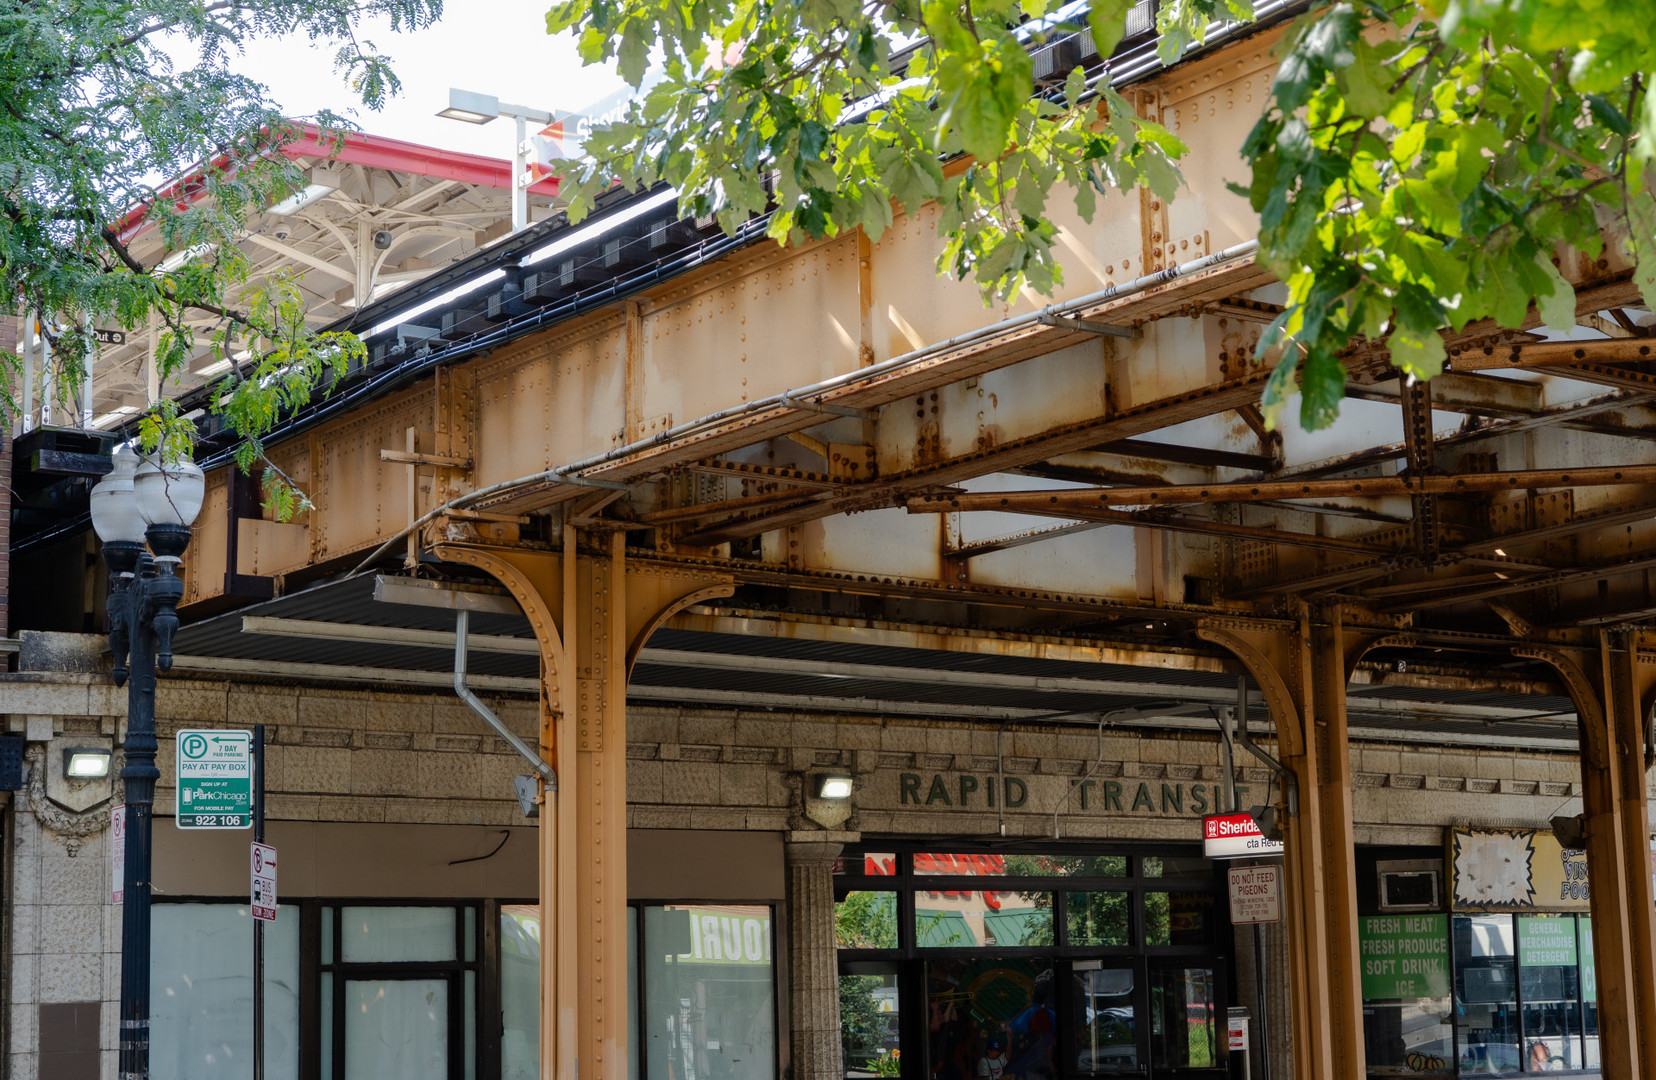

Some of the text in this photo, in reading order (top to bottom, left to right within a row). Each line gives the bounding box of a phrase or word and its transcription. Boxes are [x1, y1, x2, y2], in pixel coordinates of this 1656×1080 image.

[92, 331, 108, 341] Out
[182, 763, 246, 771] PAY AT PAY BOX
[193, 791, 247, 802] ParkChicago
[900, 773, 1249, 815] RAPID TRANSIT
[195, 815, 217, 826] 922
[220, 815, 240, 826] 106
[1219, 819, 1260, 835] Sherida
[1246, 839, 1259, 848] cta
[1231, 872, 1274, 885] DO NOT FEED
[262, 880, 271, 893] BUS
[1238, 884, 1268, 896] PIGEONS
[1560, 881, 1590, 900] FOO
[262, 893, 273, 906] STOP
[253, 905, 274, 919] TOW ZONE
[1367, 918, 1400, 934] FRESH
[1529, 922, 1562, 934] GENERAL
[1362, 938, 1446, 954] FRESH PRODUCE
[1526, 950, 1569, 962] DETERGENT
[1366, 959, 1395, 975] SOFT
[1396, 980, 1415, 995] ICE
